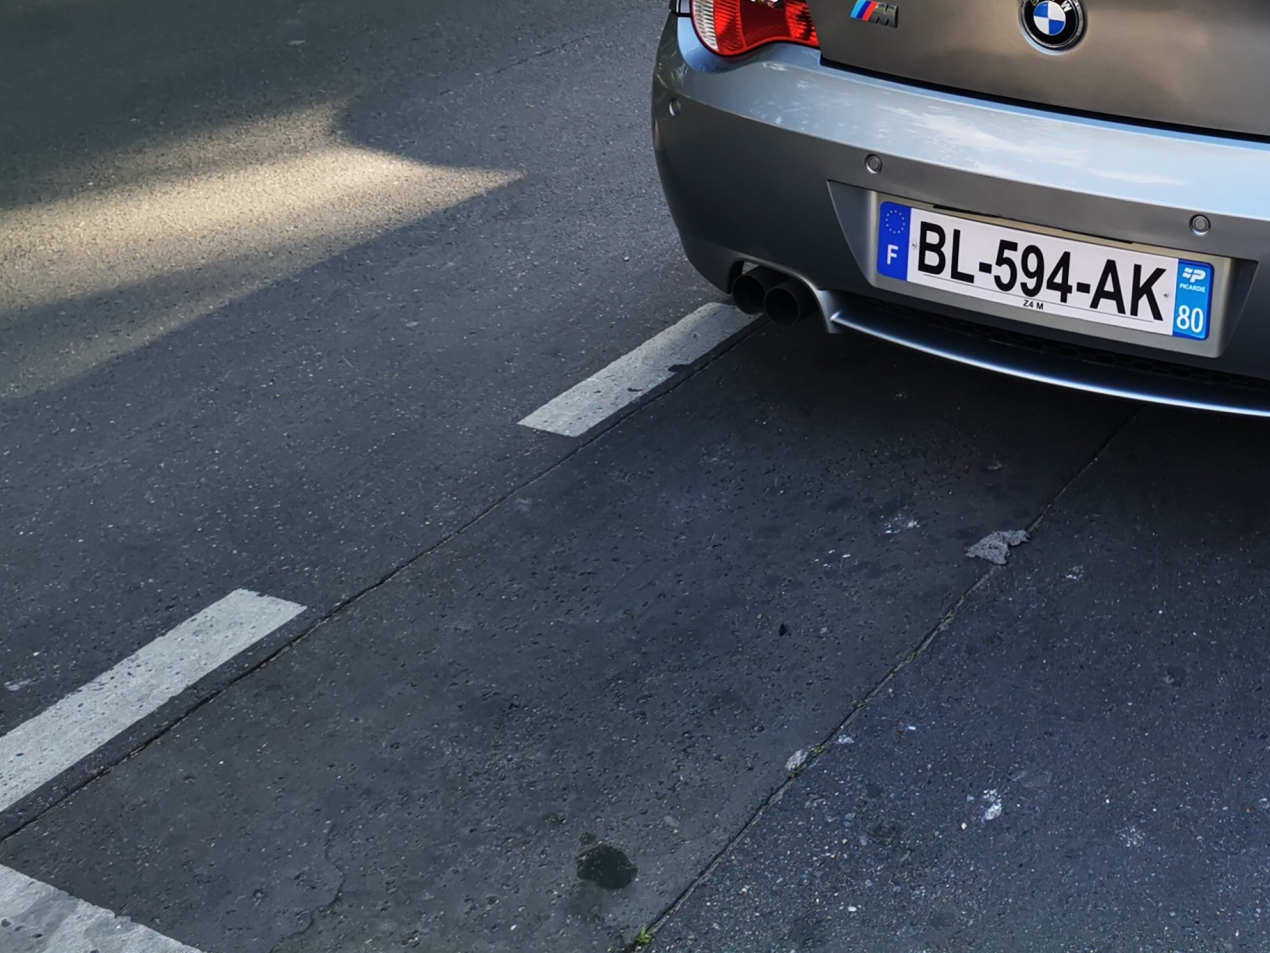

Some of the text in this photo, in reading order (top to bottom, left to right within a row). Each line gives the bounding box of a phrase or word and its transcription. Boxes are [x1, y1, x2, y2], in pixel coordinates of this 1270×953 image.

[886, 243, 899, 265] F
[917, 220, 1167, 321] BL-594-AK
[1179, 282, 1206, 294] PICARDIE
[1022, 298, 1044, 311] Z4 M
[1176, 304, 1204, 333] 80
